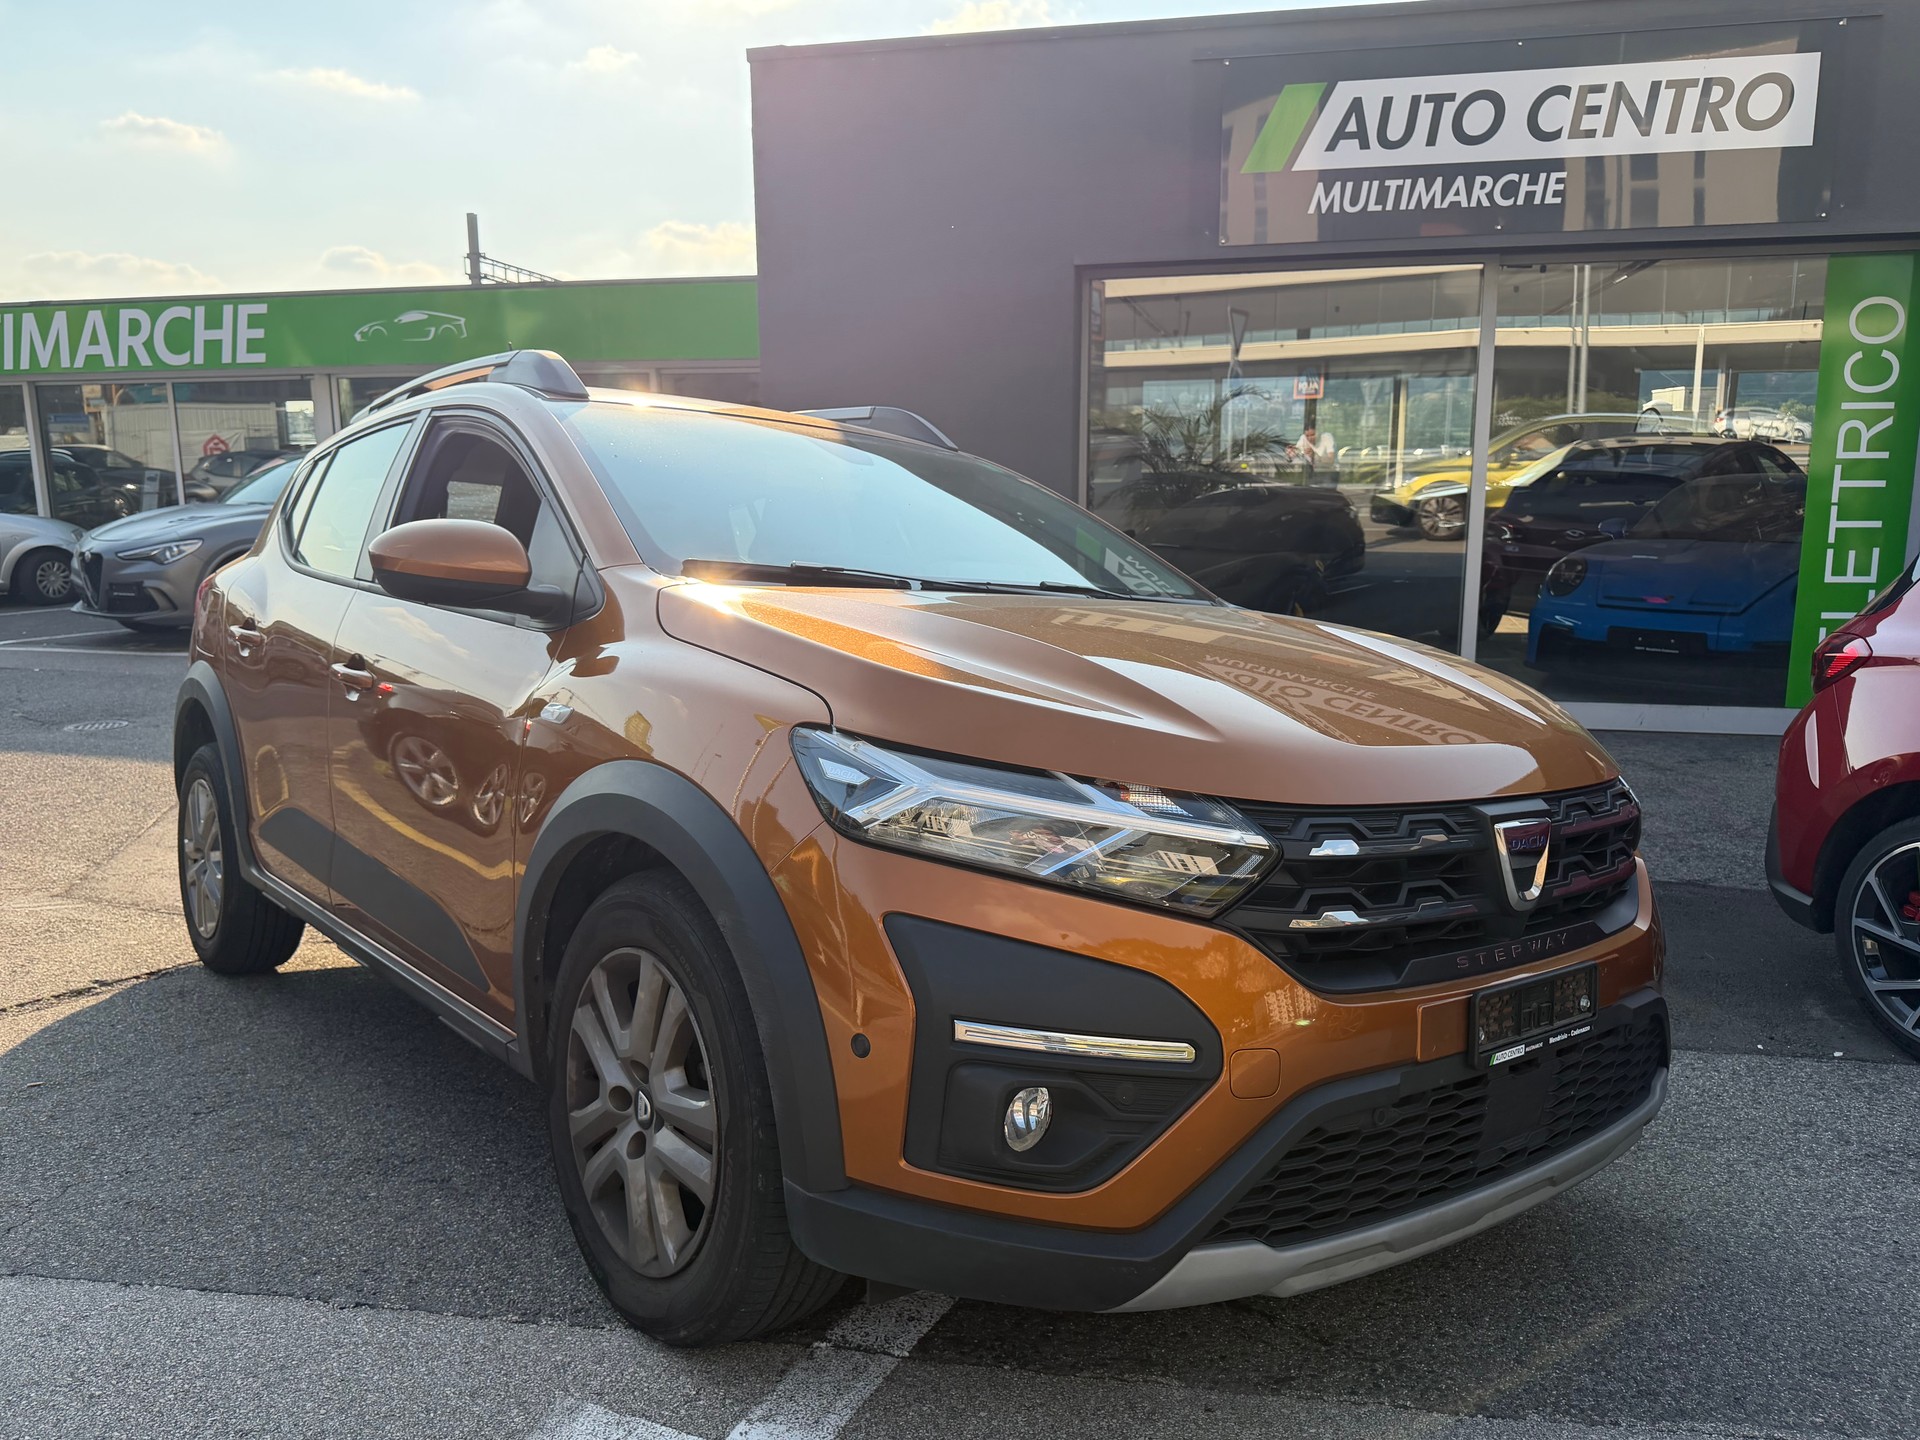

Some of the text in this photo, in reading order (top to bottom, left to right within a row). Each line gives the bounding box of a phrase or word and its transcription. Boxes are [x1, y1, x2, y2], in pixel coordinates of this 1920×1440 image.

[1324, 72, 1795, 152] AUTO CENTRO
[1307, 171, 1567, 215] MULTIMARCHE
[0, 303, 268, 371] IMARCHE
[1819, 296, 1905, 645] LETTRICO
[1511, 834, 1546, 851] DACIA
[1457, 932, 1567, 968] STEPWAY
[1496, 1046, 1524, 1061] AUTO CENTRO
